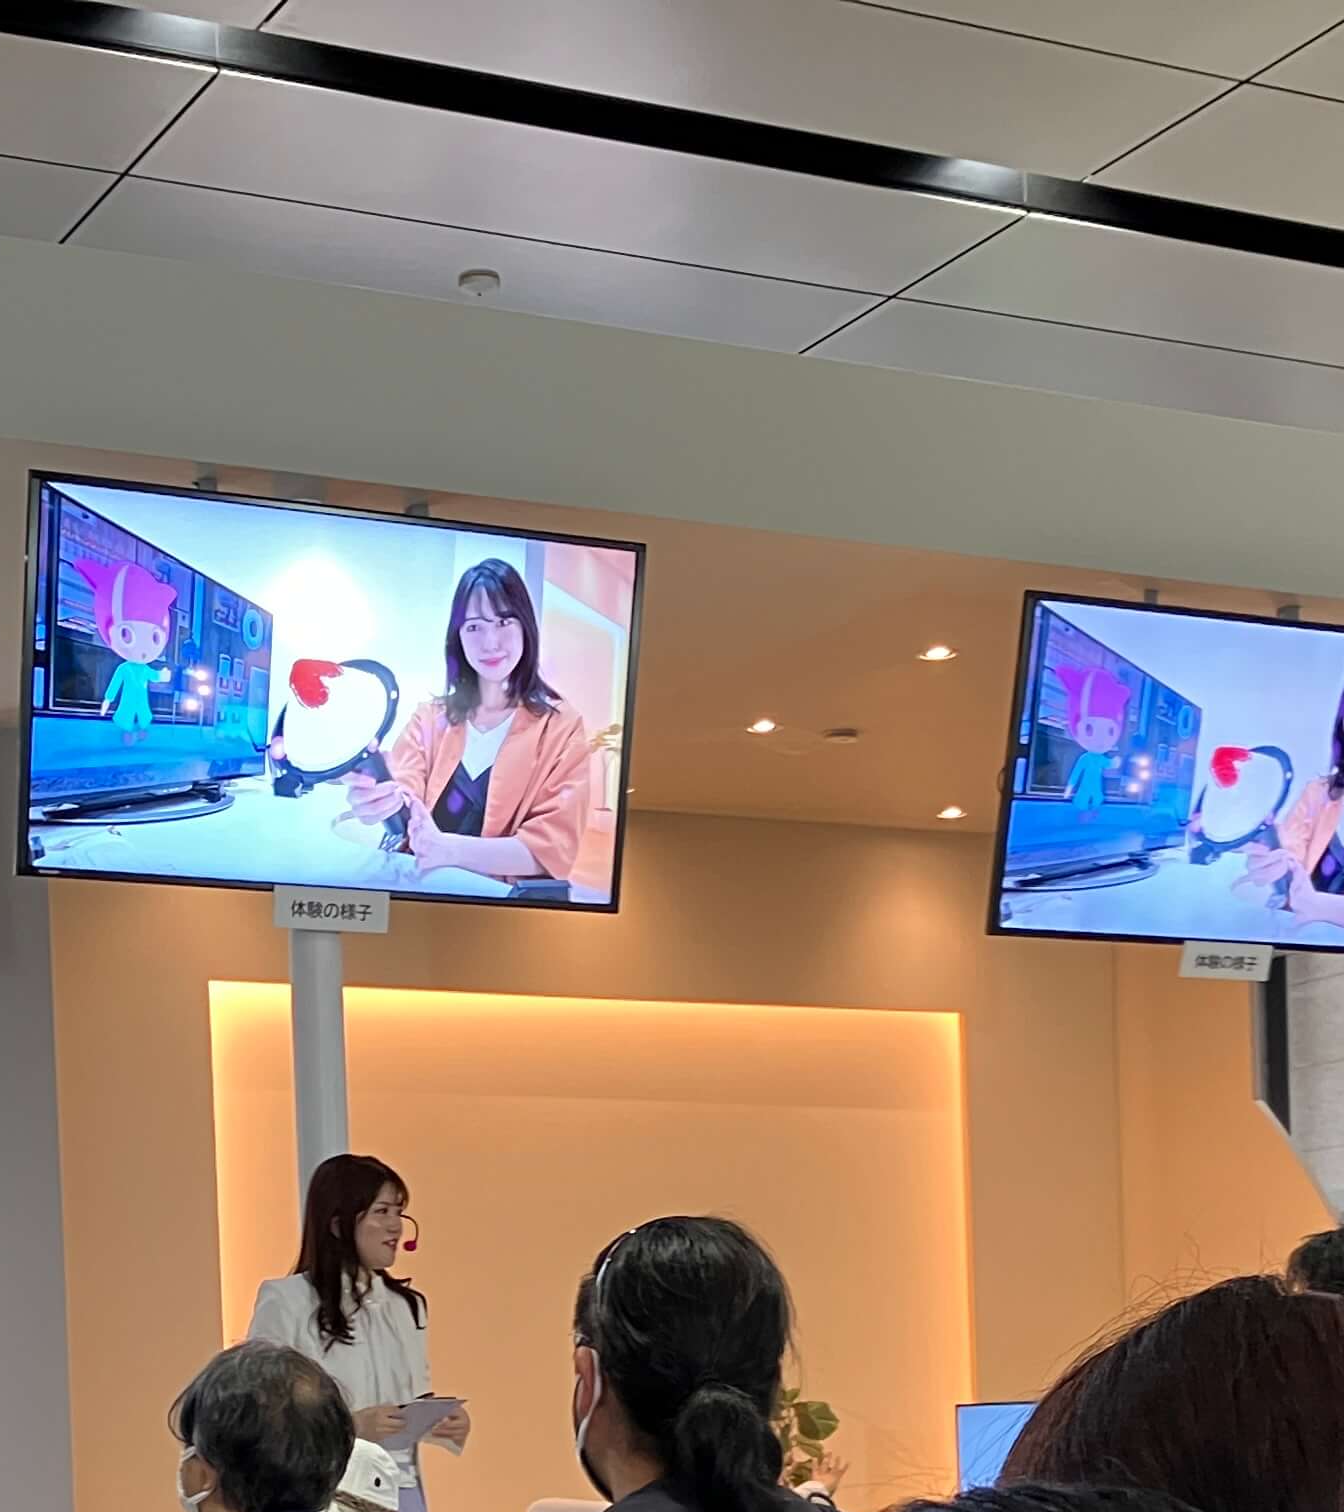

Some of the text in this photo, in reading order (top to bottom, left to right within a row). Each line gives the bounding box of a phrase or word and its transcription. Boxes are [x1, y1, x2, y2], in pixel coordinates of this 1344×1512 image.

[291, 900, 372, 921] 体験の様子
